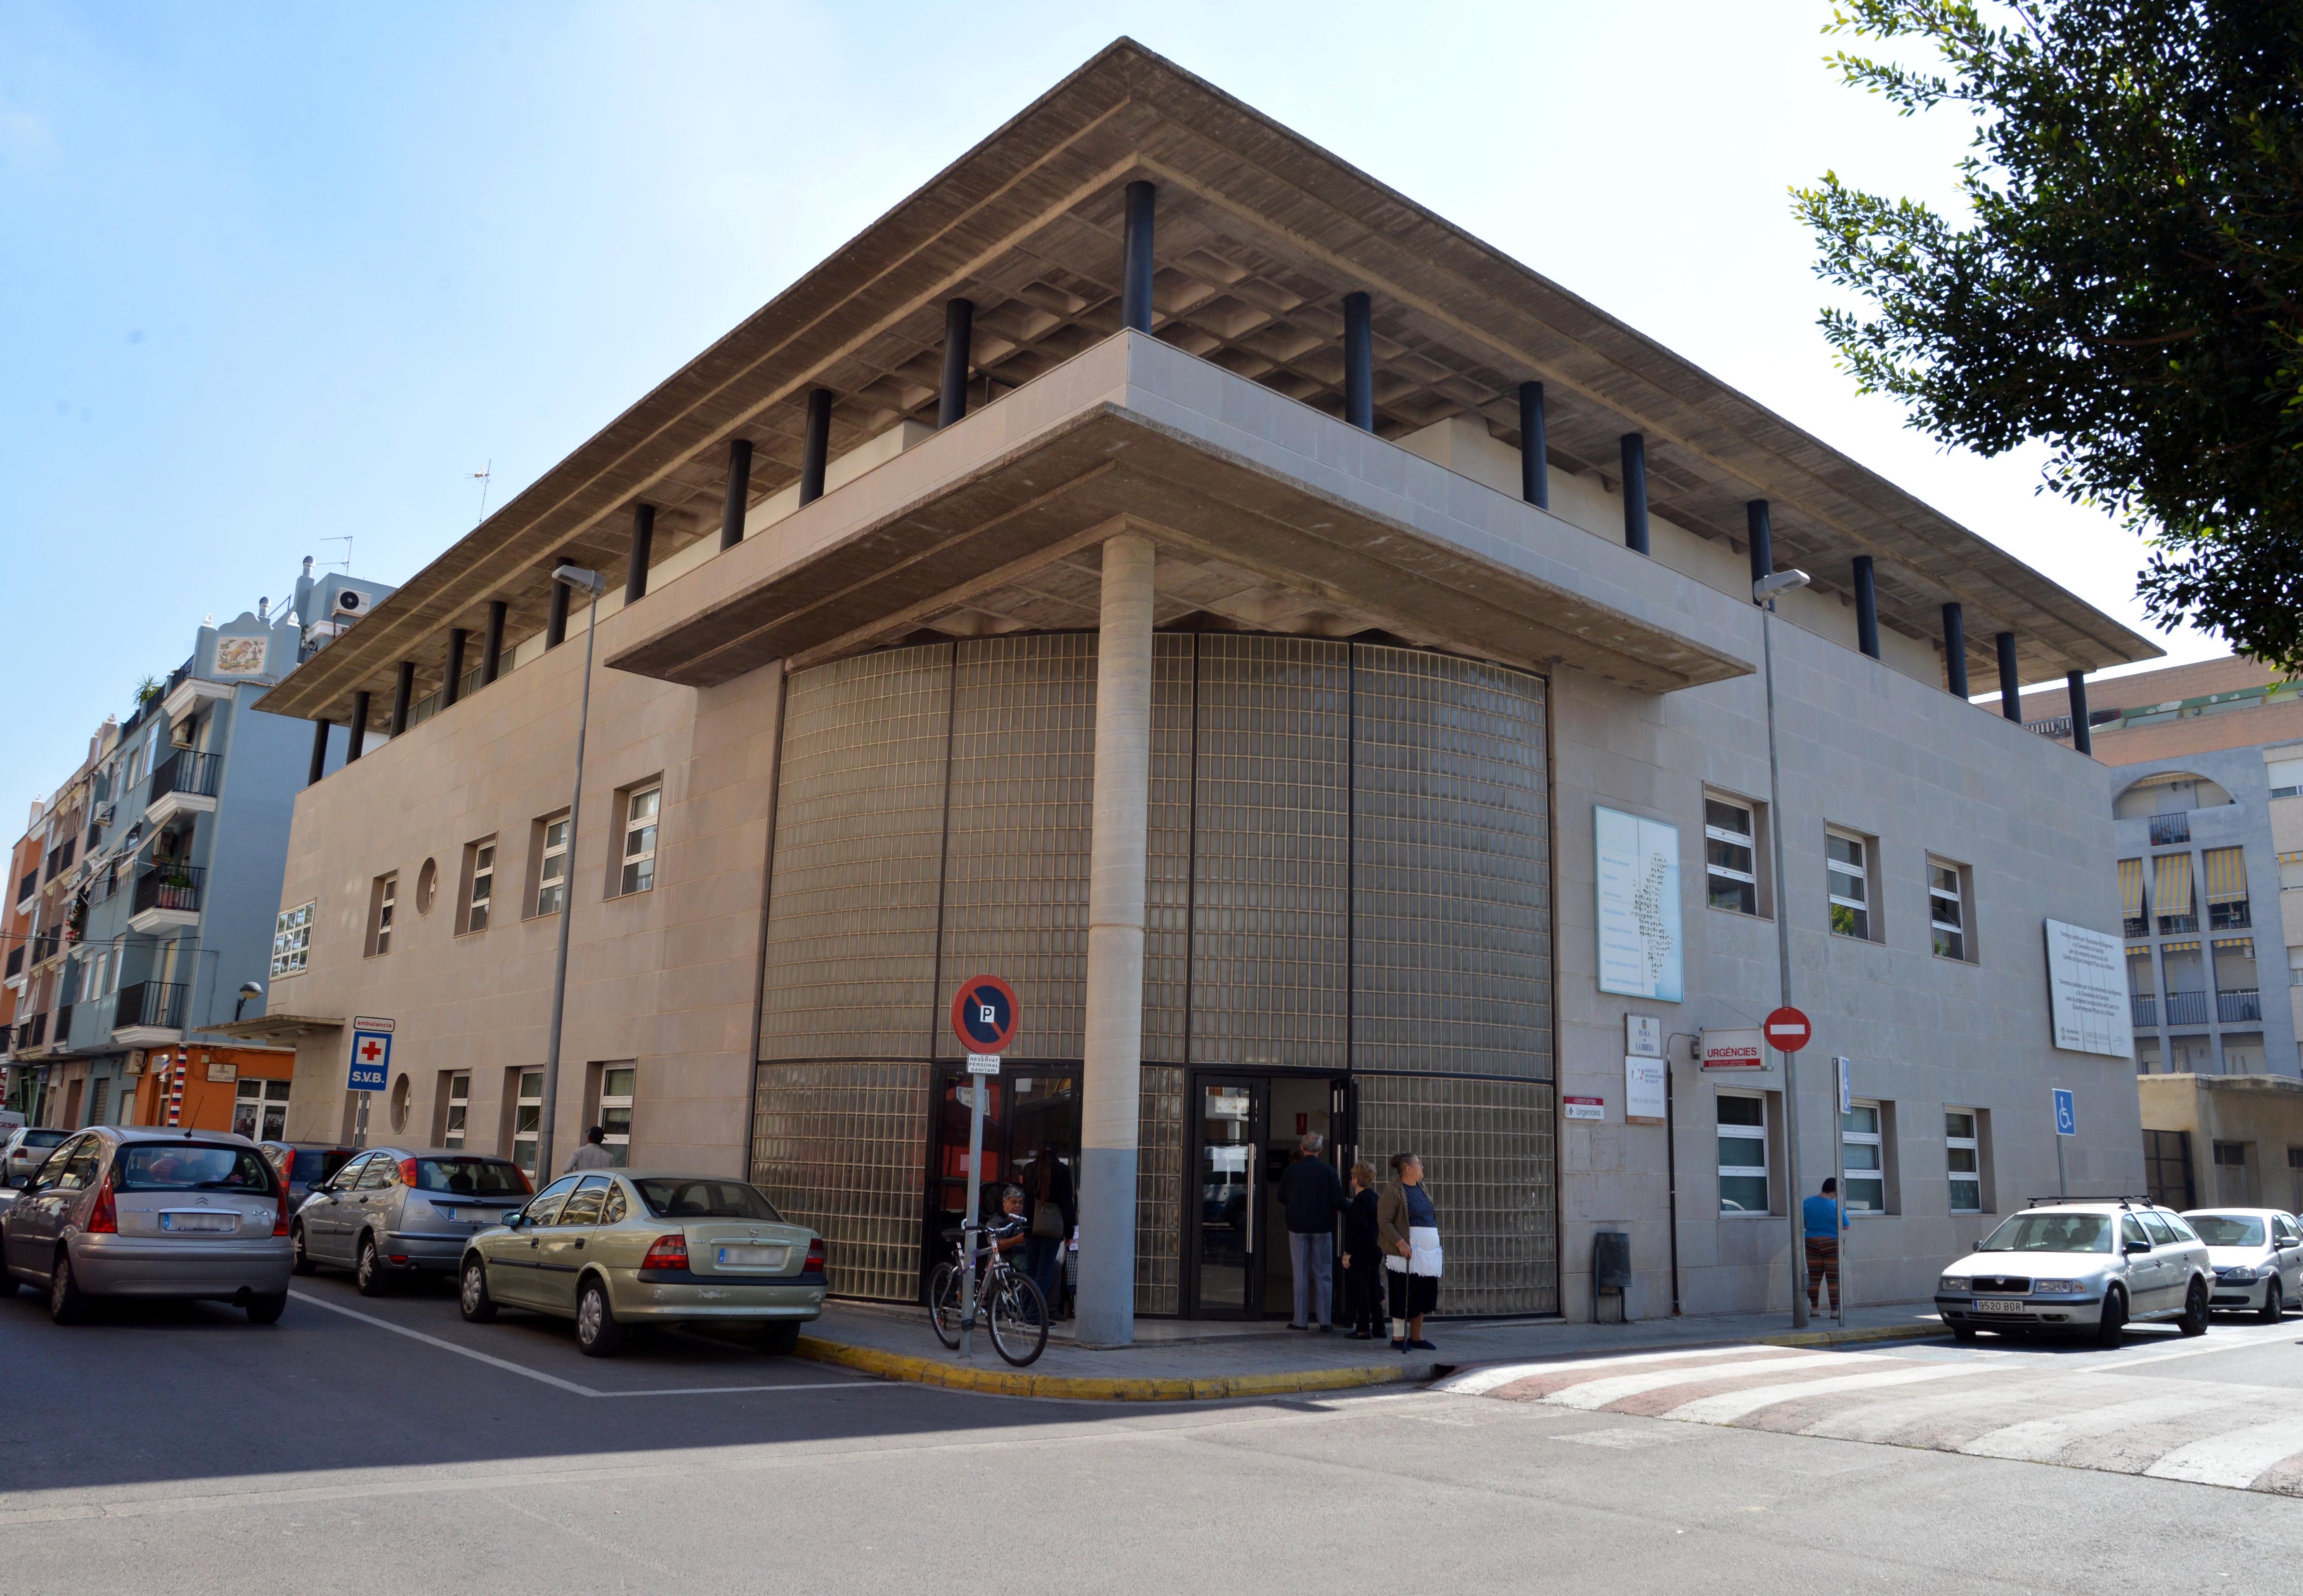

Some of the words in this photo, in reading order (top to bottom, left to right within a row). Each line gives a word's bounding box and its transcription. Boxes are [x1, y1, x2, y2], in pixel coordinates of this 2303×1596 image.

[983, 1007, 992, 1021] P
[1707, 1046, 1757, 1057] URGÈNCIES
[351, 1071, 385, 1083] S.V.B.
[1576, 1108, 1601, 1118] Urgències
[1979, 1301, 2001, 1311] 9520
[2004, 1302, 2021, 1311] BDR
